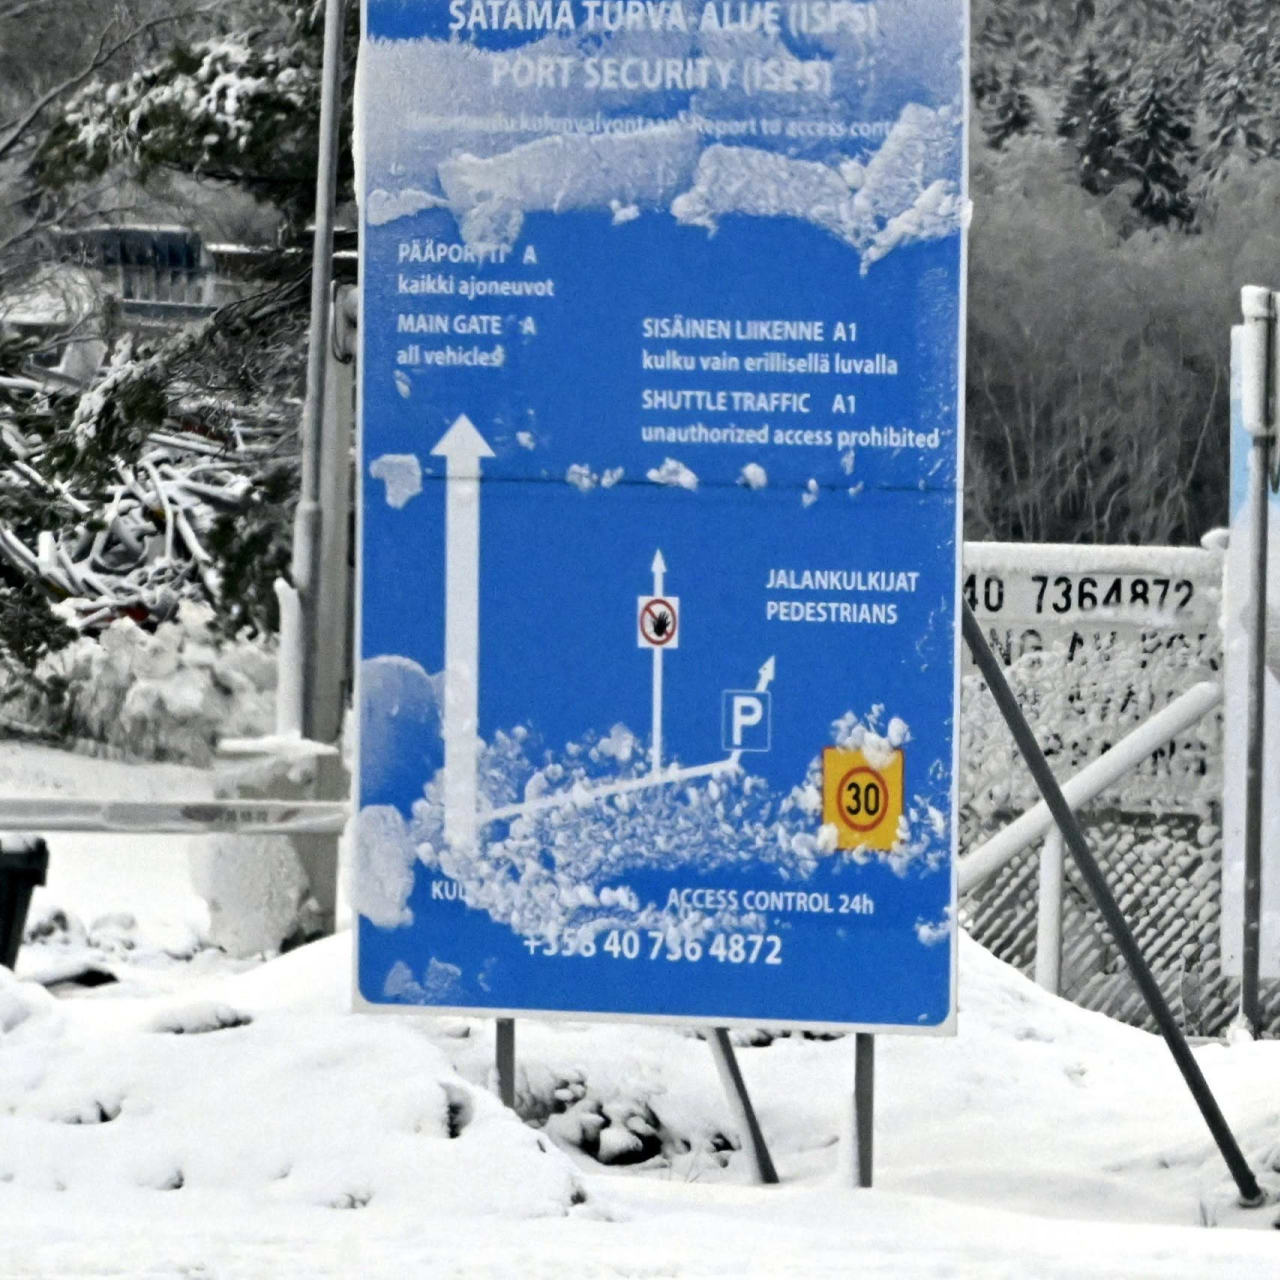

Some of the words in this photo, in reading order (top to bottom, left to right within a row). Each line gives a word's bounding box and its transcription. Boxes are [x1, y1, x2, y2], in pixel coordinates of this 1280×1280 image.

[491, 56, 578, 89] PORT
[584, 57, 735, 91] SECURITY
[522, 244, 538, 265] A
[398, 274, 455, 295] kaikki
[458, 275, 556, 301] ajoneuvot
[397, 314, 450, 333] MAIN
[453, 315, 503, 334] GATE
[521, 316, 537, 335] A
[642, 314, 732, 340] SISÄINEN
[735, 318, 825, 342] LIIKENNE
[833, 321, 858, 343] A1
[396, 344, 421, 365] all
[424, 344, 502, 366] vehicles
[642, 348, 696, 371] kulku
[699, 350, 741, 371] vain
[743, 351, 831, 374] erillisellä
[834, 353, 899, 375] luvalla
[641, 389, 728, 412] SHUTTLE
[731, 391, 812, 413] TRAFFIC
[831, 394, 857, 414] A1
[641, 422, 770, 445] unauthorized
[773, 427, 834, 446] access
[837, 426, 941, 451] prohibited
[766, 568, 921, 592] JALANKULKIJAT
[1031, 575, 1196, 617] 7364872
[766, 600, 899, 625] PEDESTRIANS
[732, 695, 764, 746] P
[846, 782, 881, 817] 30
[667, 887, 739, 911] ACCESS
[743, 890, 834, 914] CONTROL
[838, 893, 875, 915] 24h
[603, 929, 641, 959] 40
[708, 933, 784, 965] 4872
